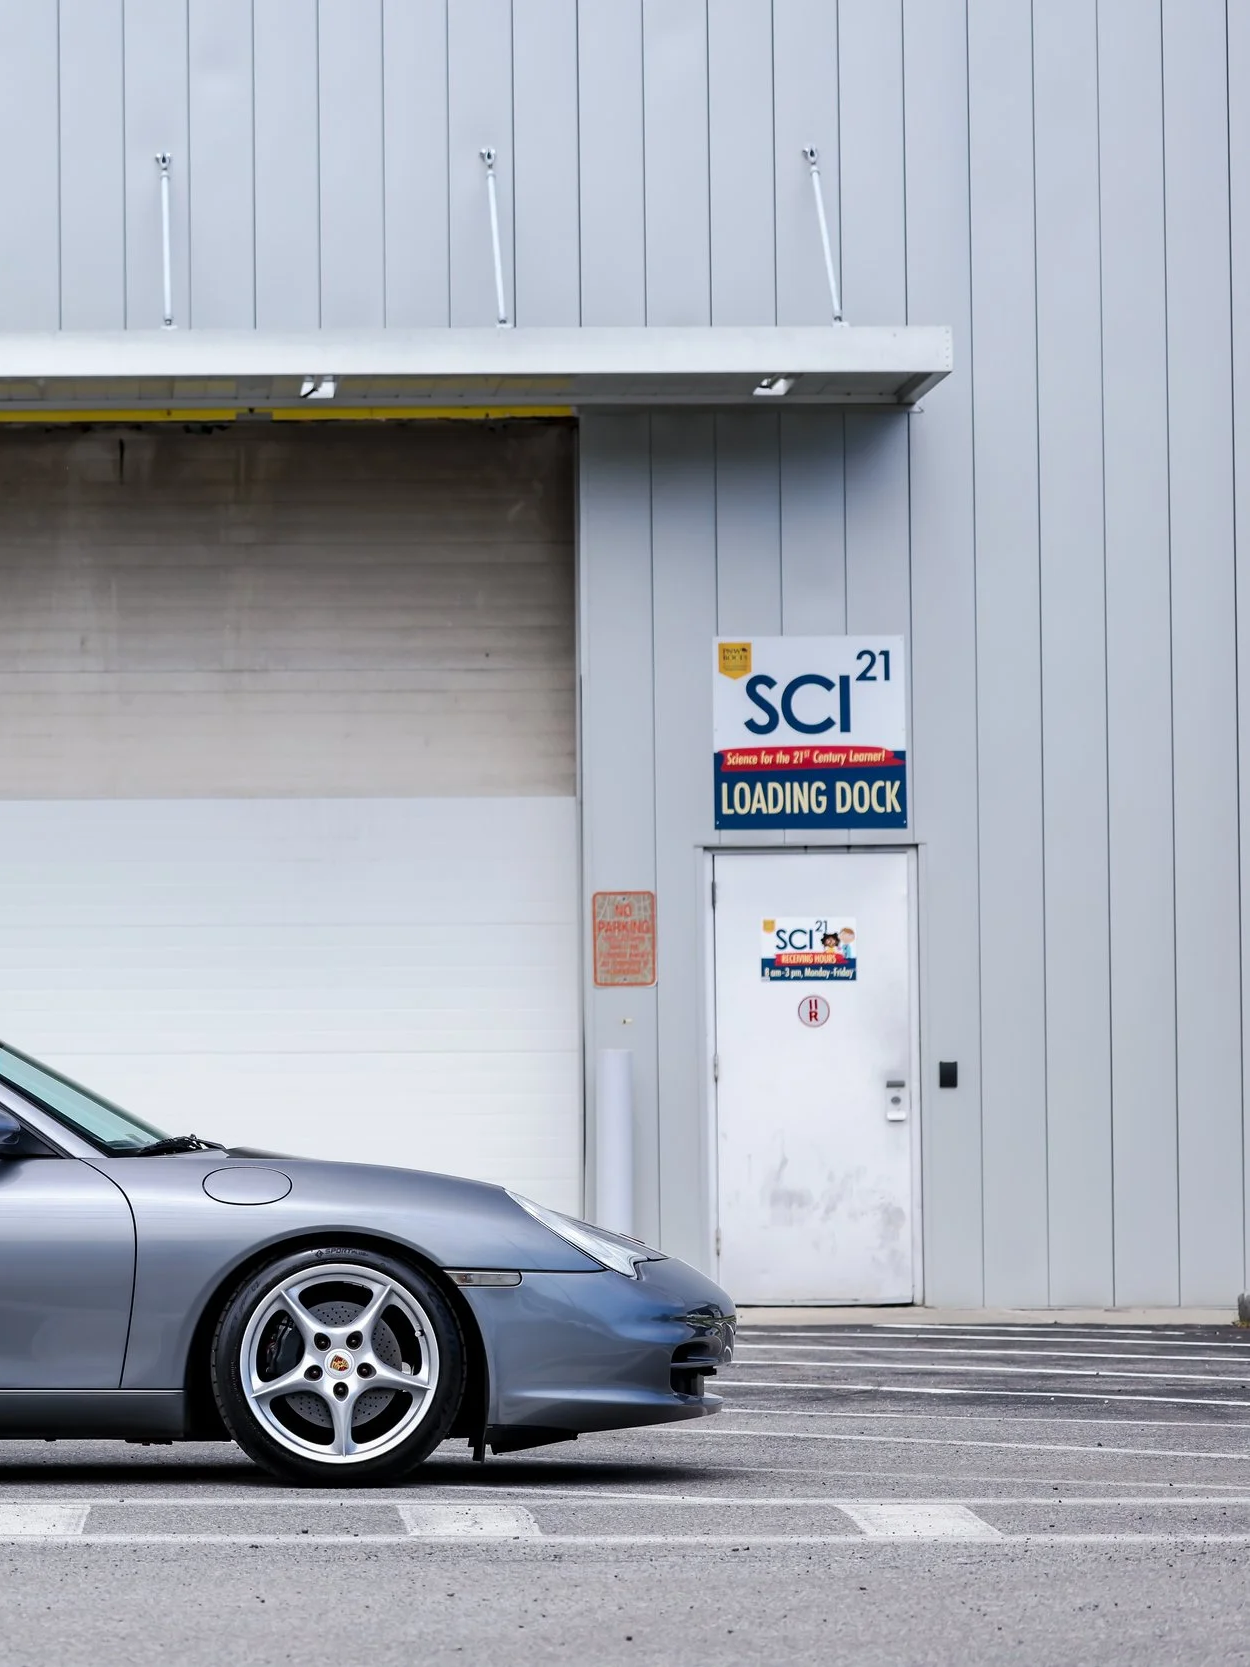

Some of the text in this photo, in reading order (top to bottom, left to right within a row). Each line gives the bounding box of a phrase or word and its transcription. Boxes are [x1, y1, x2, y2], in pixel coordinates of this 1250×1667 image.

[744, 650, 890, 735] SCI 21
[727, 751, 757, 765] Science
[761, 751, 774, 765] for
[776, 751, 790, 765] the
[813, 750, 847, 766] Century
[849, 749, 886, 763] Learner!
[721, 780, 902, 815] LOADING DOCK
[614, 903, 632, 917] NO
[597, 920, 650, 934] PARKING
[776, 920, 828, 950] SCI 21
[781, 954, 837, 964] RECEIVING HOURS
[809, 1011, 818, 1022] R
